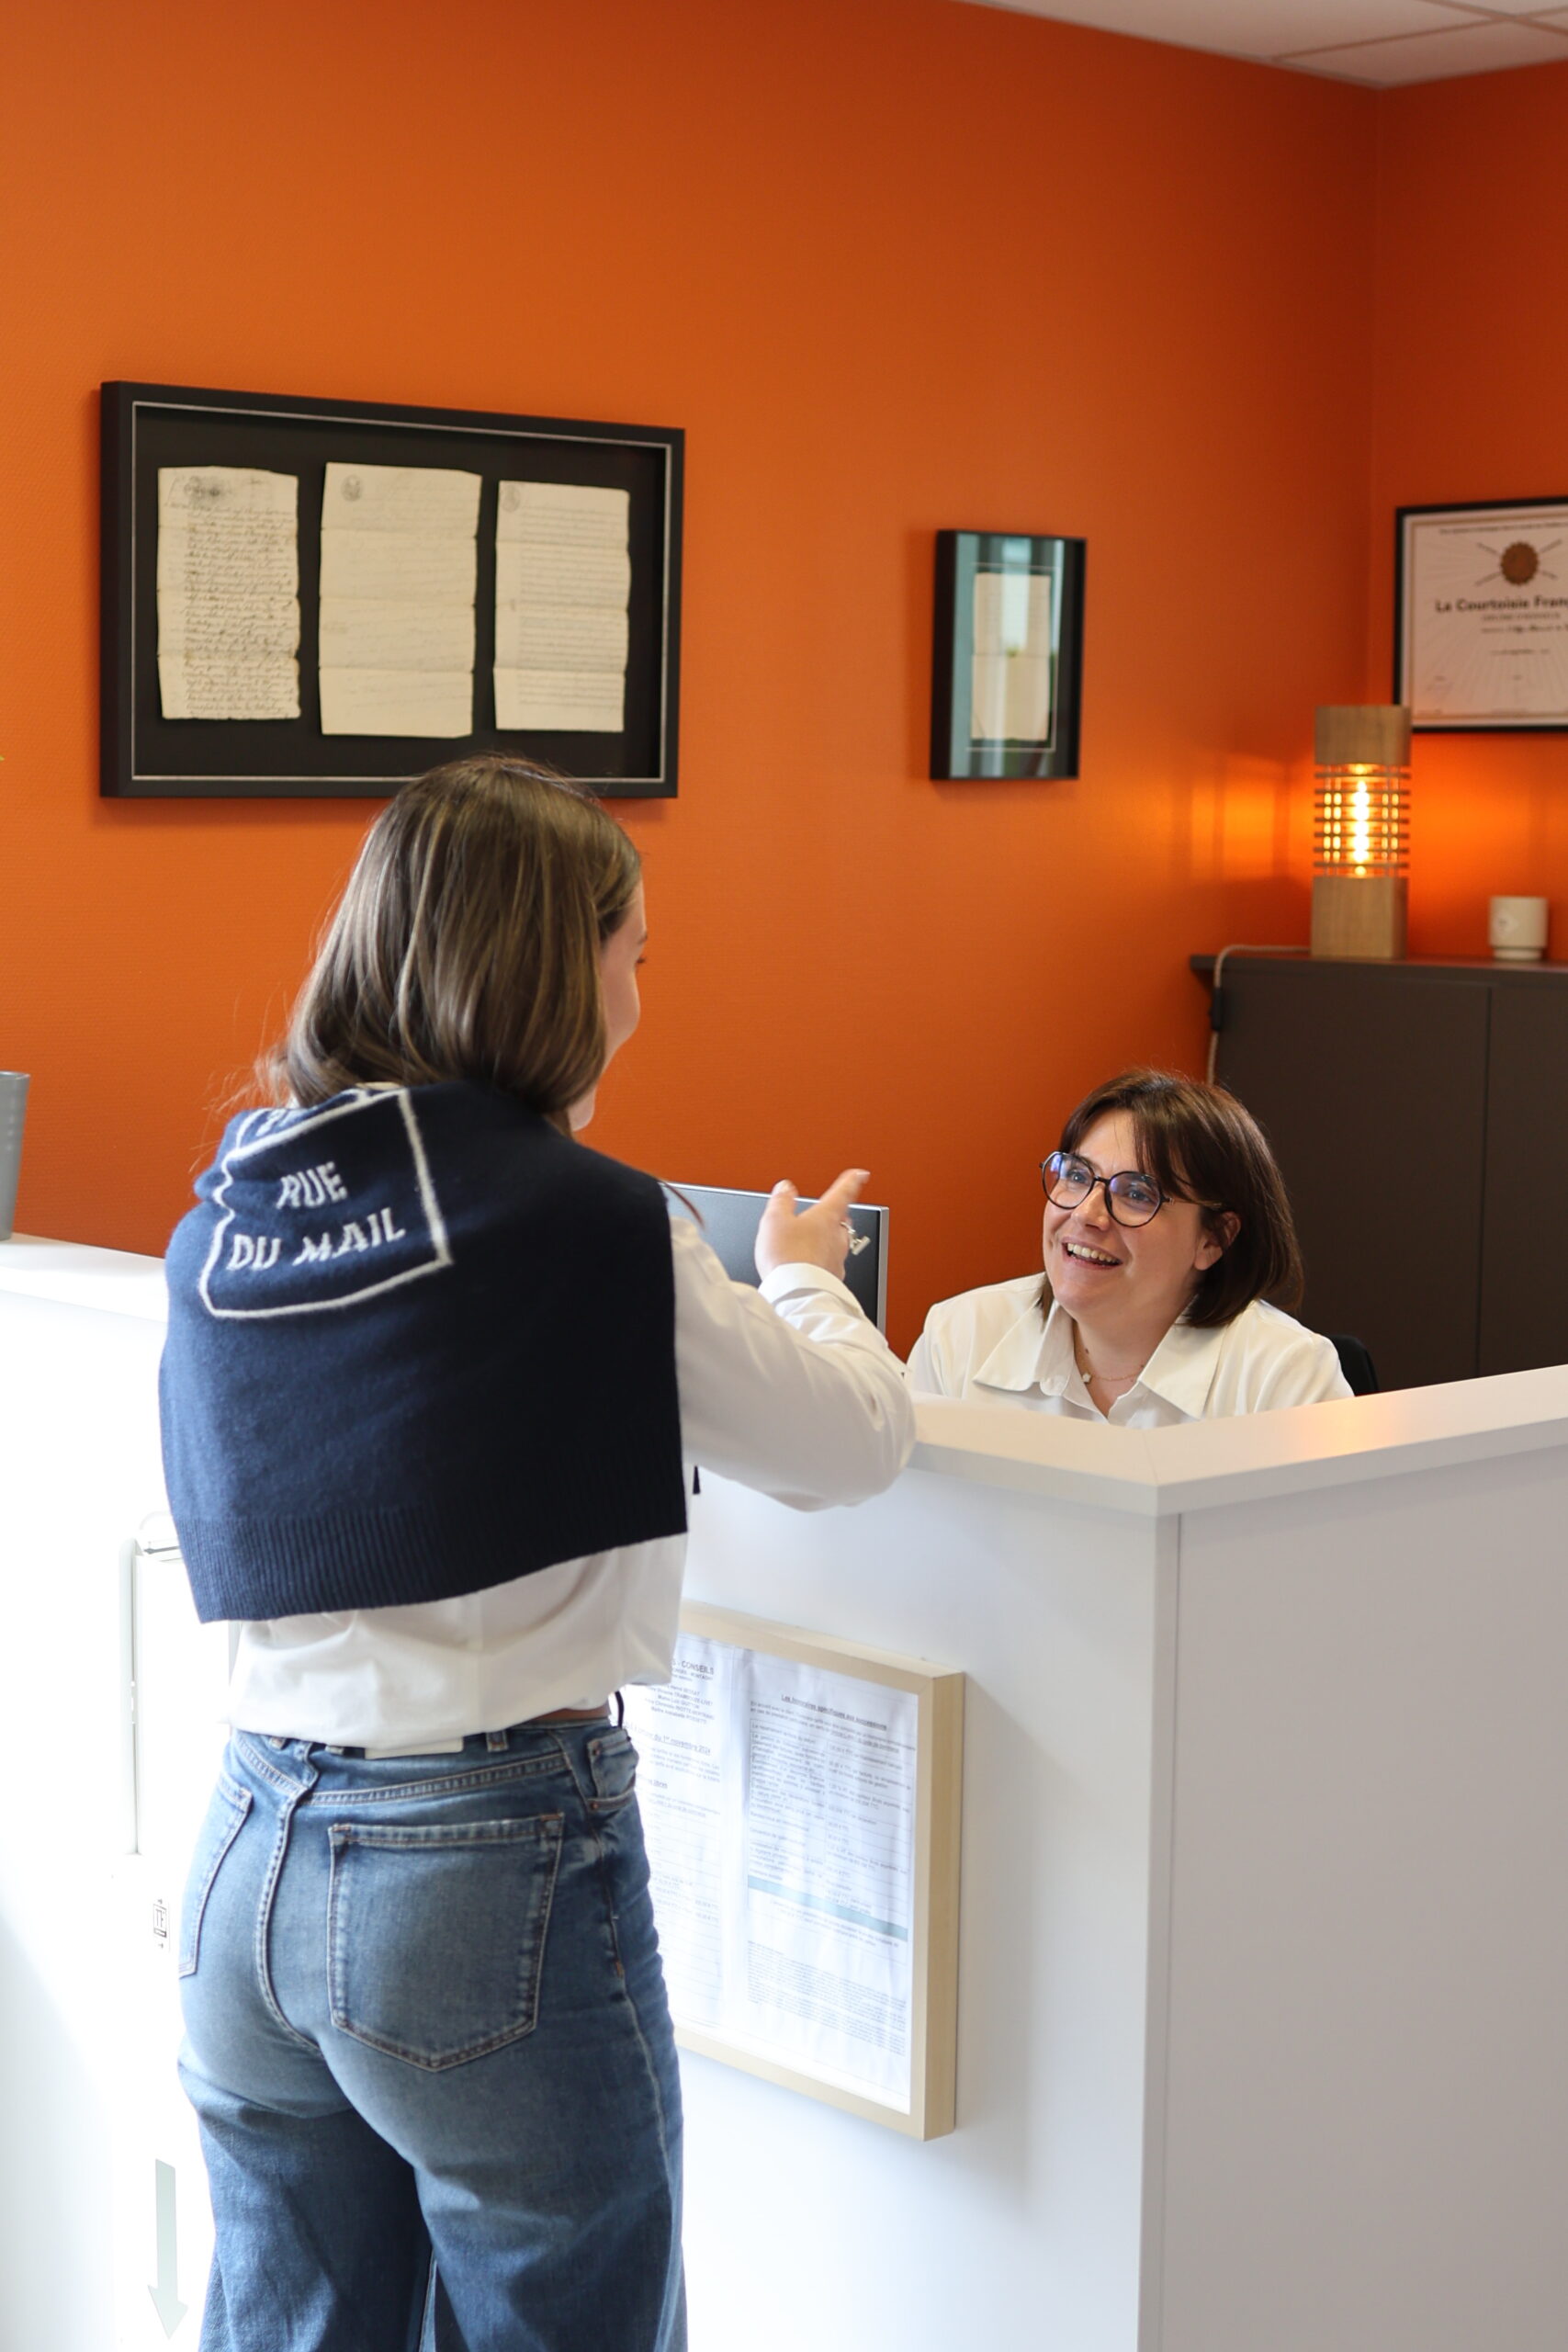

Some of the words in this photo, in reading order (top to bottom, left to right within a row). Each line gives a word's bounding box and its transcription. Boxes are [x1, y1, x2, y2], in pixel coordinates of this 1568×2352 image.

[276, 1160, 348, 1210] RUE
[226, 1233, 281, 1272] DU
[291, 1206, 407, 1267] MAIL
